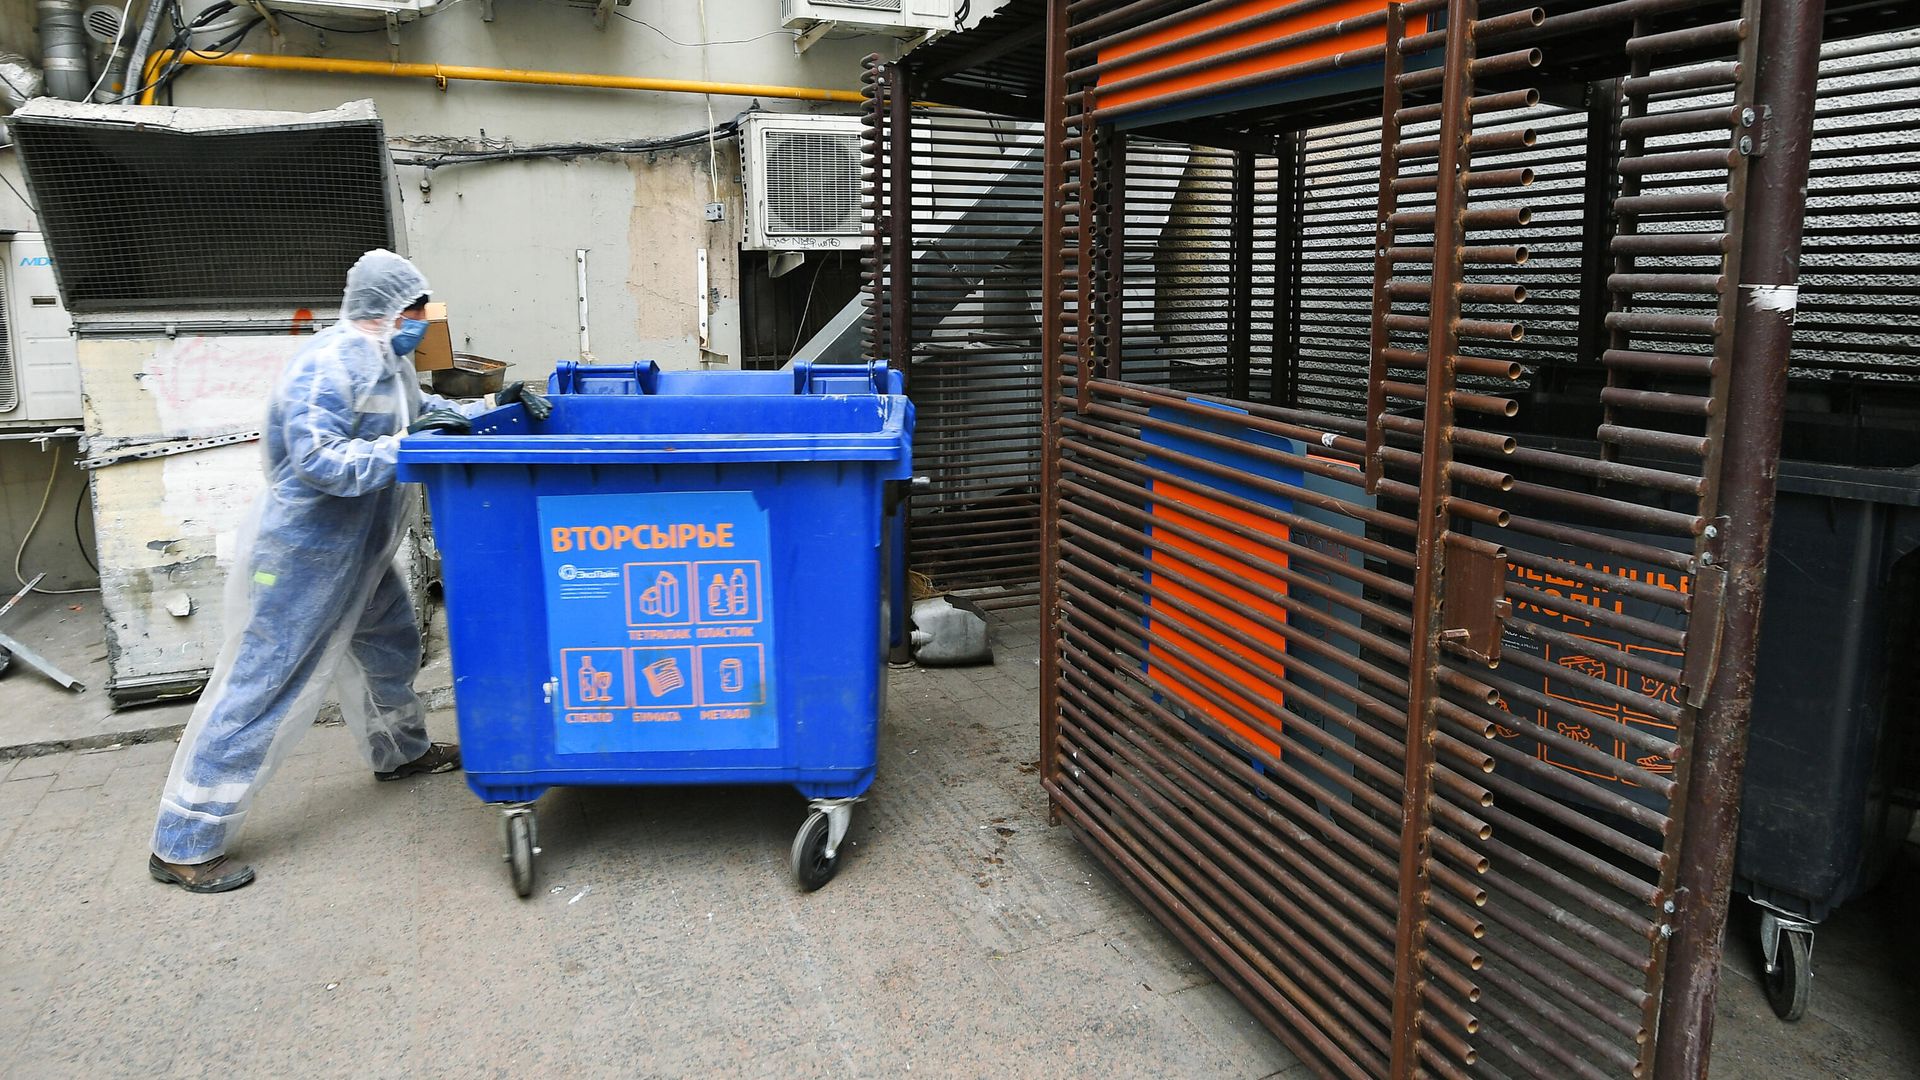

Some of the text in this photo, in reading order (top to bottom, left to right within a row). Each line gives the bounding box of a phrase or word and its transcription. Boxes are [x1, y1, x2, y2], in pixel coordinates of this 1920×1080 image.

[20, 257, 54, 266] MD
[551, 523, 735, 552] ВТОРСЫРЬЕ
[627, 627, 754, 640] ТЕТРАПАК ПЛАСТИК
[565, 709, 751, 723] СТЕКЛО БУМАГА МЕТАЛЛ
